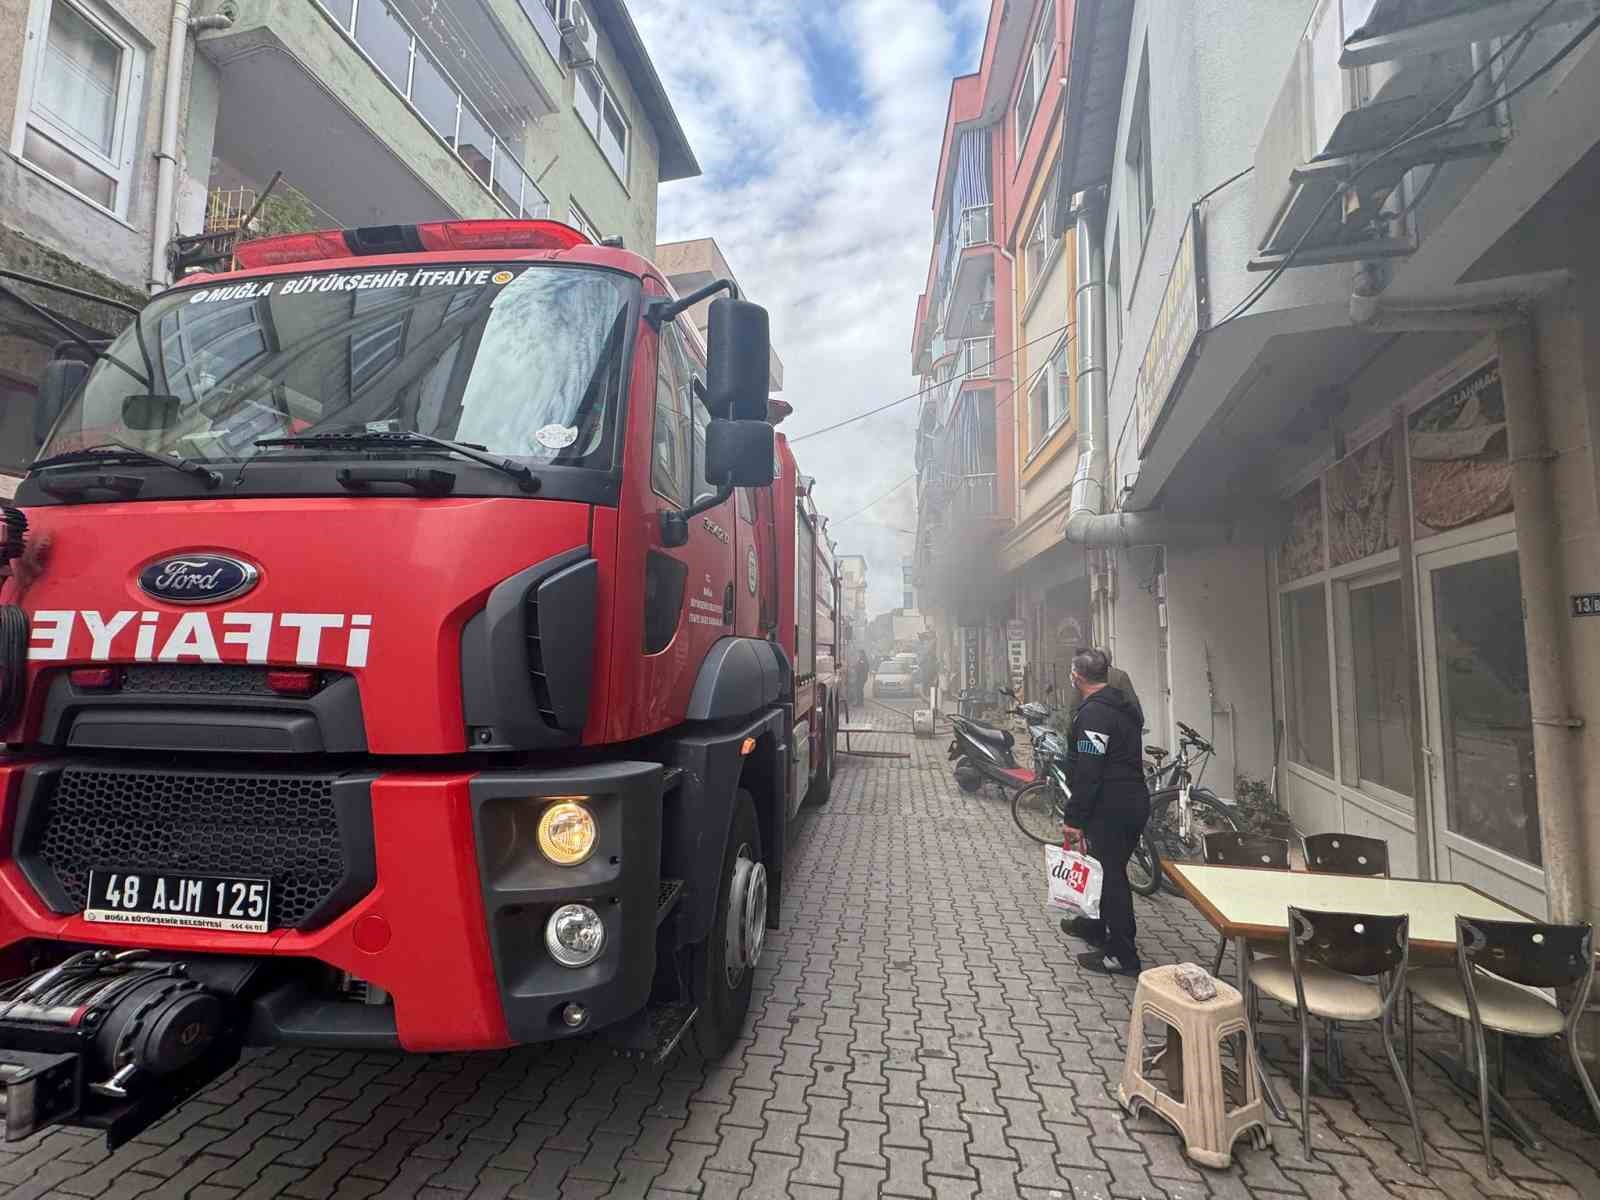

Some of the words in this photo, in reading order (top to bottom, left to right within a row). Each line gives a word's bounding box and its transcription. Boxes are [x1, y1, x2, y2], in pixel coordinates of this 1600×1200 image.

[207, 281, 272, 302] MUĞLA
[280, 269, 408, 295] BÜYÜKŞEHİR
[409, 267, 492, 286] İTFAİYE
[154, 560, 224, 591] Ford
[105, 874, 140, 908] 48
[152, 877, 202, 913] AJM
[216, 882, 264, 918] 125
